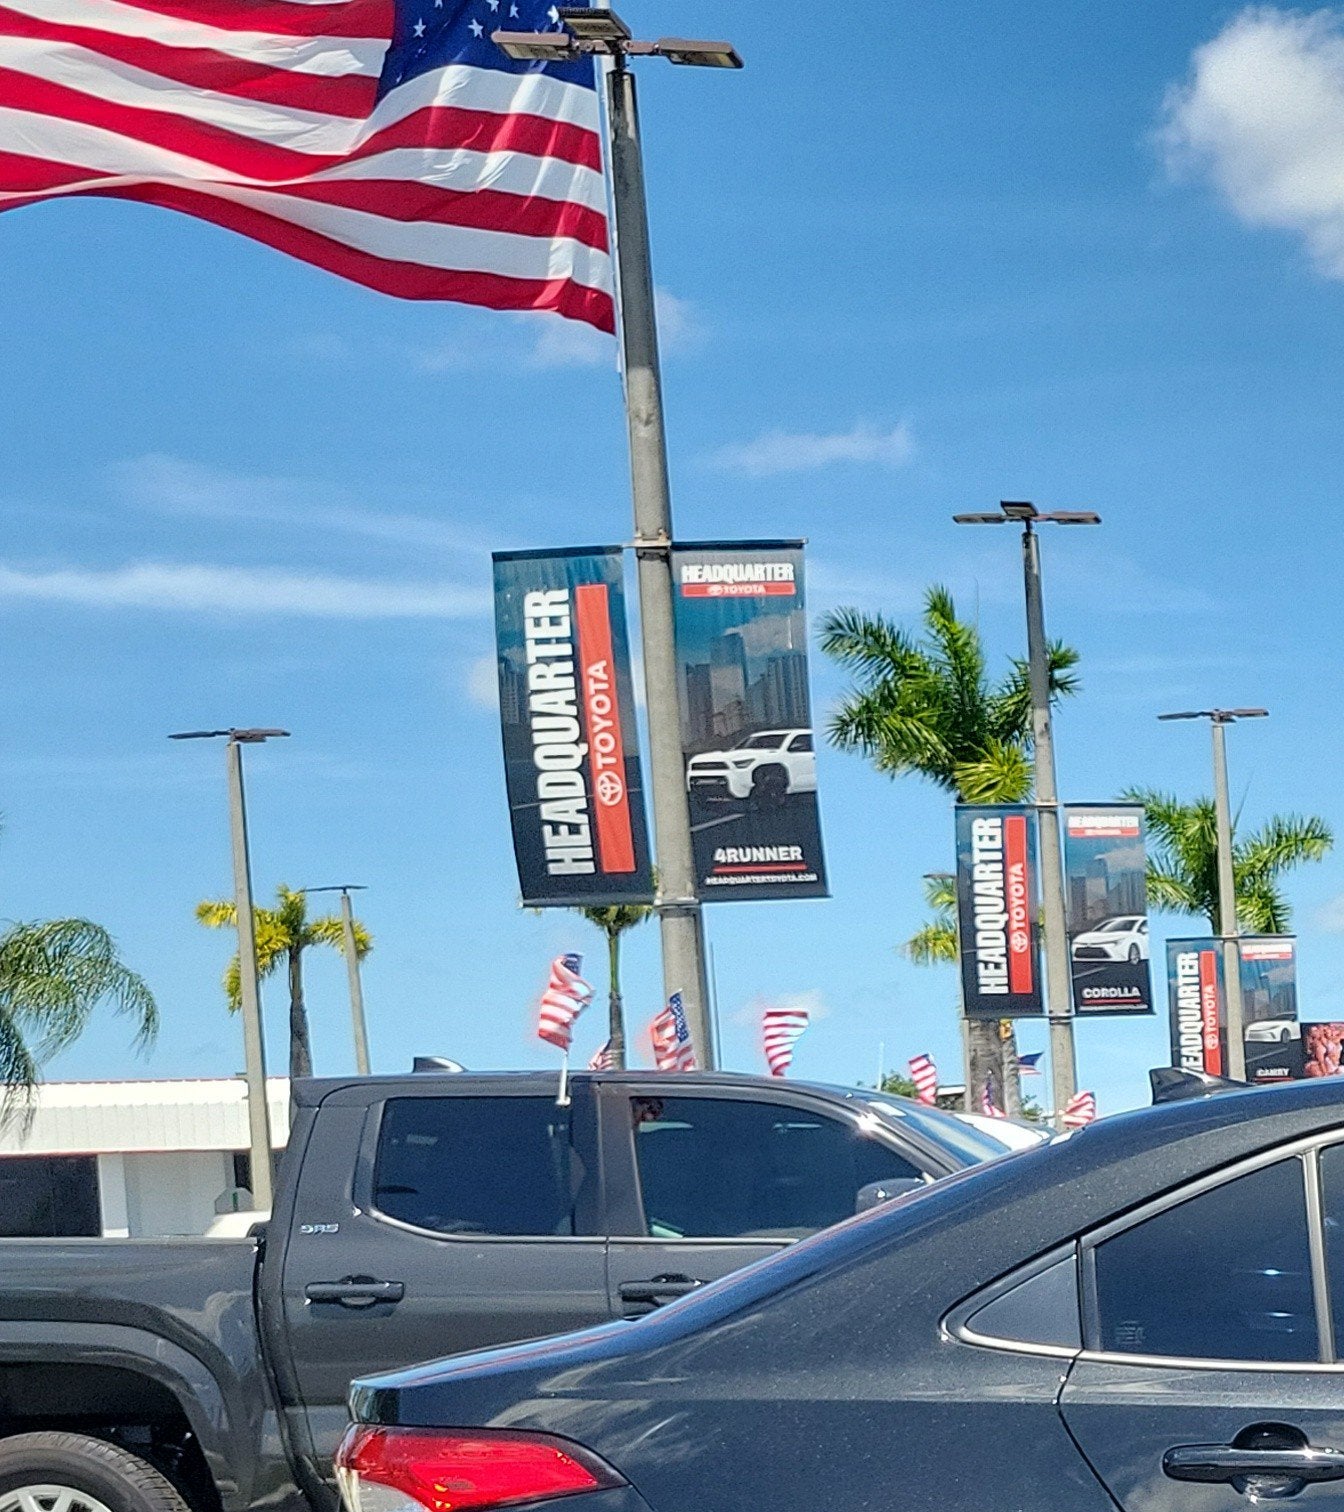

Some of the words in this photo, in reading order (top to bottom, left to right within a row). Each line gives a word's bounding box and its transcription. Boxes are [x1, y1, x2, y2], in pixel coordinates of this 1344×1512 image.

[681, 563, 795, 583] HEADQUARTER
[723, 584, 767, 595] TOYOTA
[523, 588, 596, 876] HEADQUARTER
[590, 659, 618, 769] TOYOTA
[714, 845, 803, 863] 4RUNNER
[971, 817, 1010, 995] HEADQUARTER
[1009, 863, 1027, 928] TOYOTA
[1082, 986, 1142, 998] COROLLA
